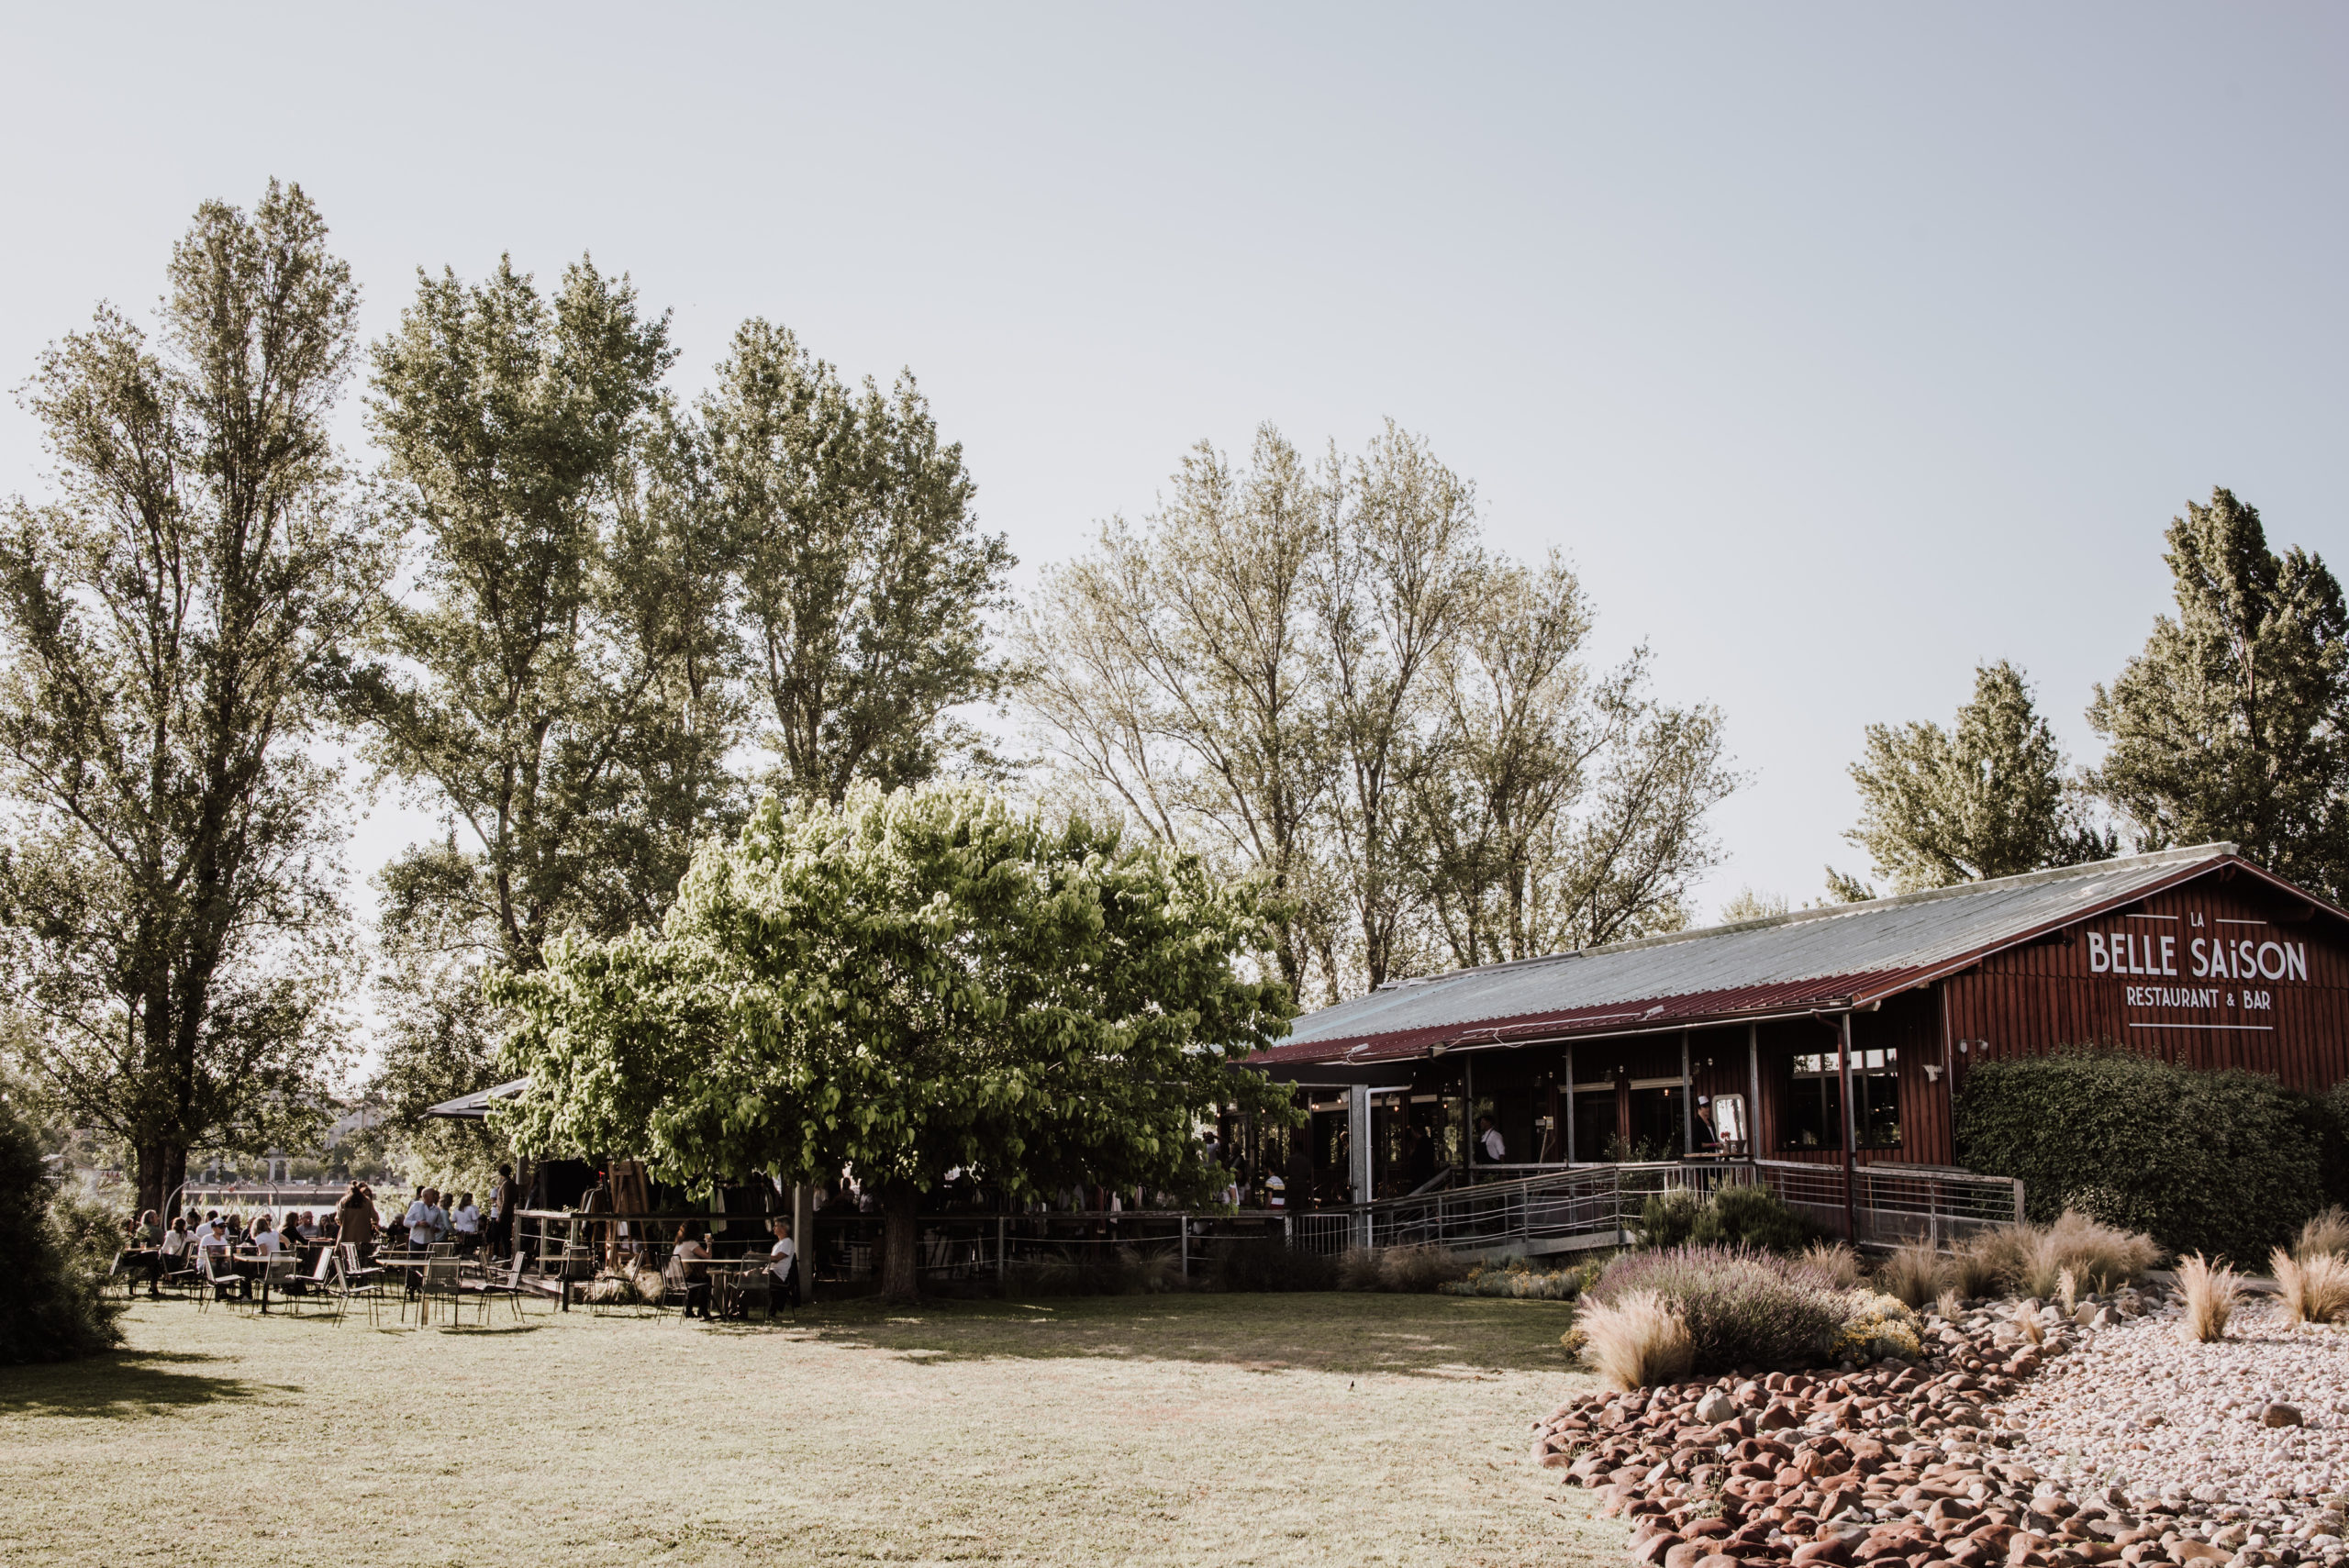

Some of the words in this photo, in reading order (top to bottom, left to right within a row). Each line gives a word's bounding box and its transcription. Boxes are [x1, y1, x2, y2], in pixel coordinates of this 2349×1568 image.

[2190, 911, 2205, 928] LA
[2087, 931, 2177, 976] BELLE
[2126, 985, 2220, 1008] RESTAURANT
[2226, 992, 2235, 1006] &
[2243, 989, 2271, 1010] BAR
